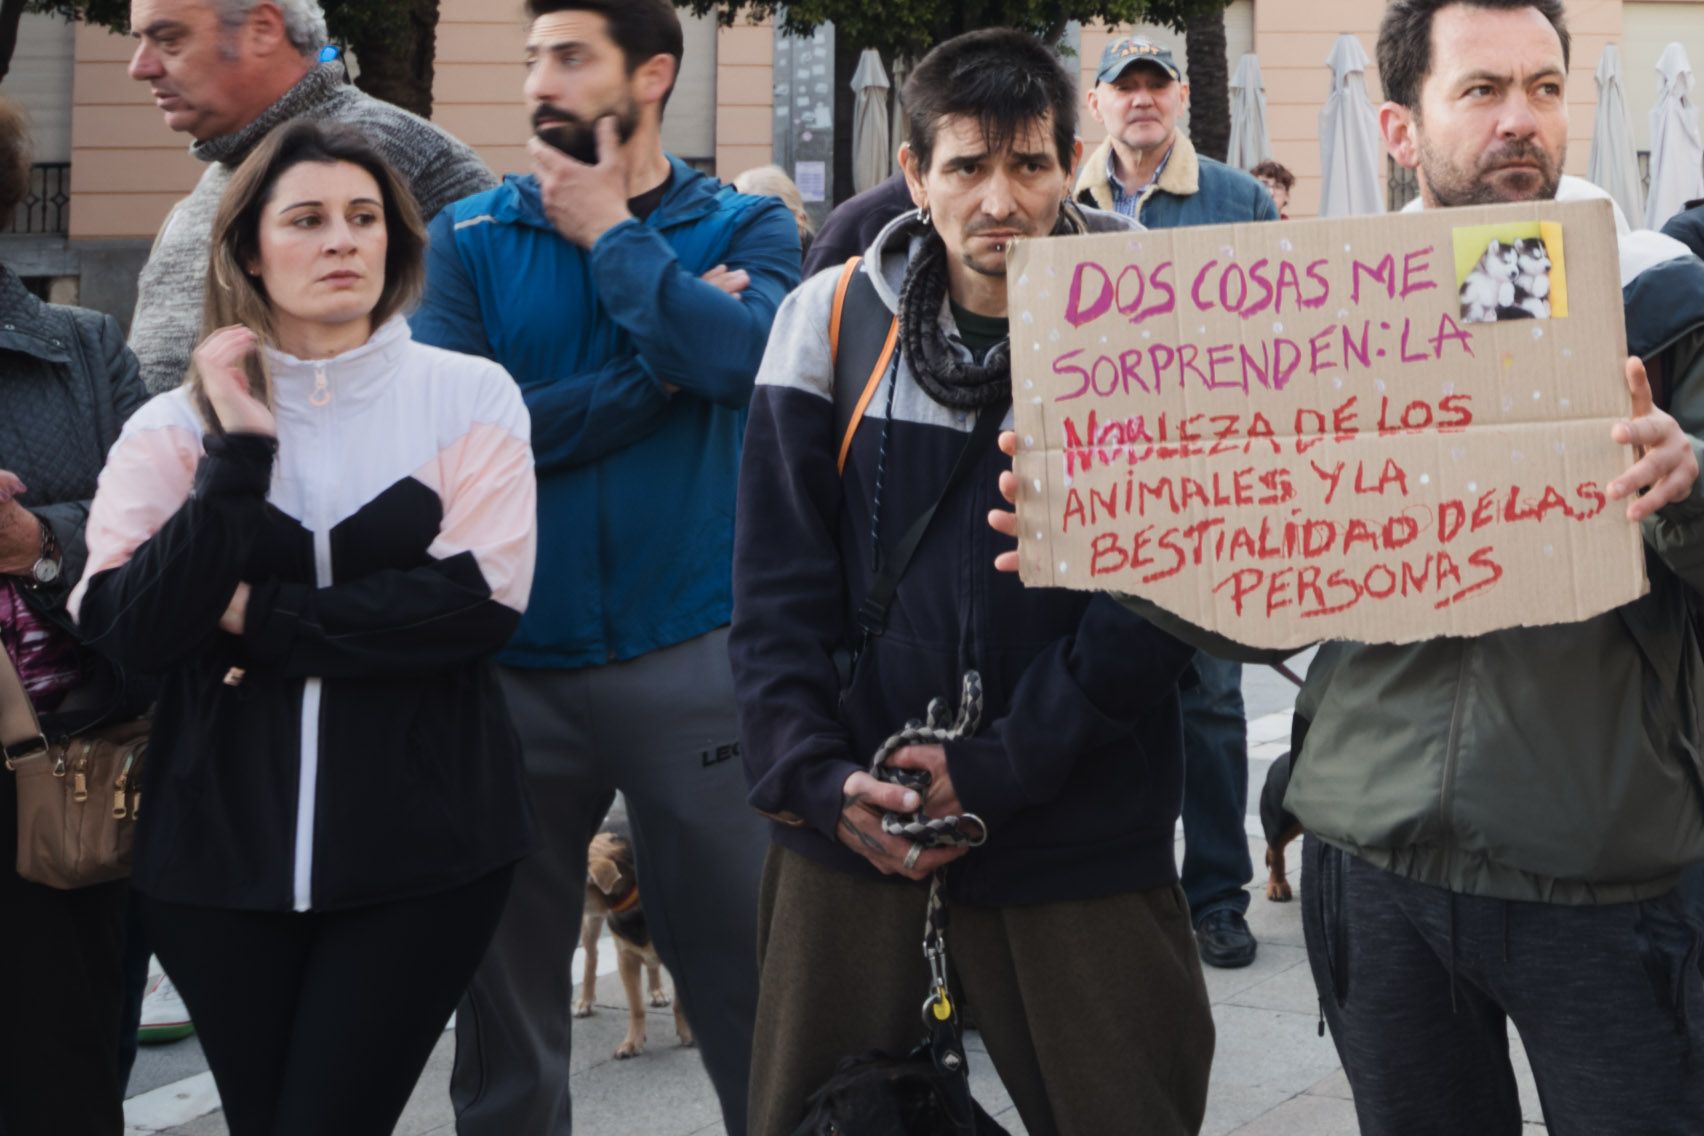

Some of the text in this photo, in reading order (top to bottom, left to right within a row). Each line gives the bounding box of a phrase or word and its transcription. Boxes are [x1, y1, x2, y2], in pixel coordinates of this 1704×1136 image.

[1064, 246, 1438, 327] DOS COSAS ME
[1400, 313, 1476, 363] LA
[1062, 394, 1474, 476] NOBLEZA DE LOS
[1063, 468, 1297, 532] ANIMALES
[1091, 507, 1419, 583] BESTIALIDAD
[1212, 546, 1504, 618] PERSONAS
